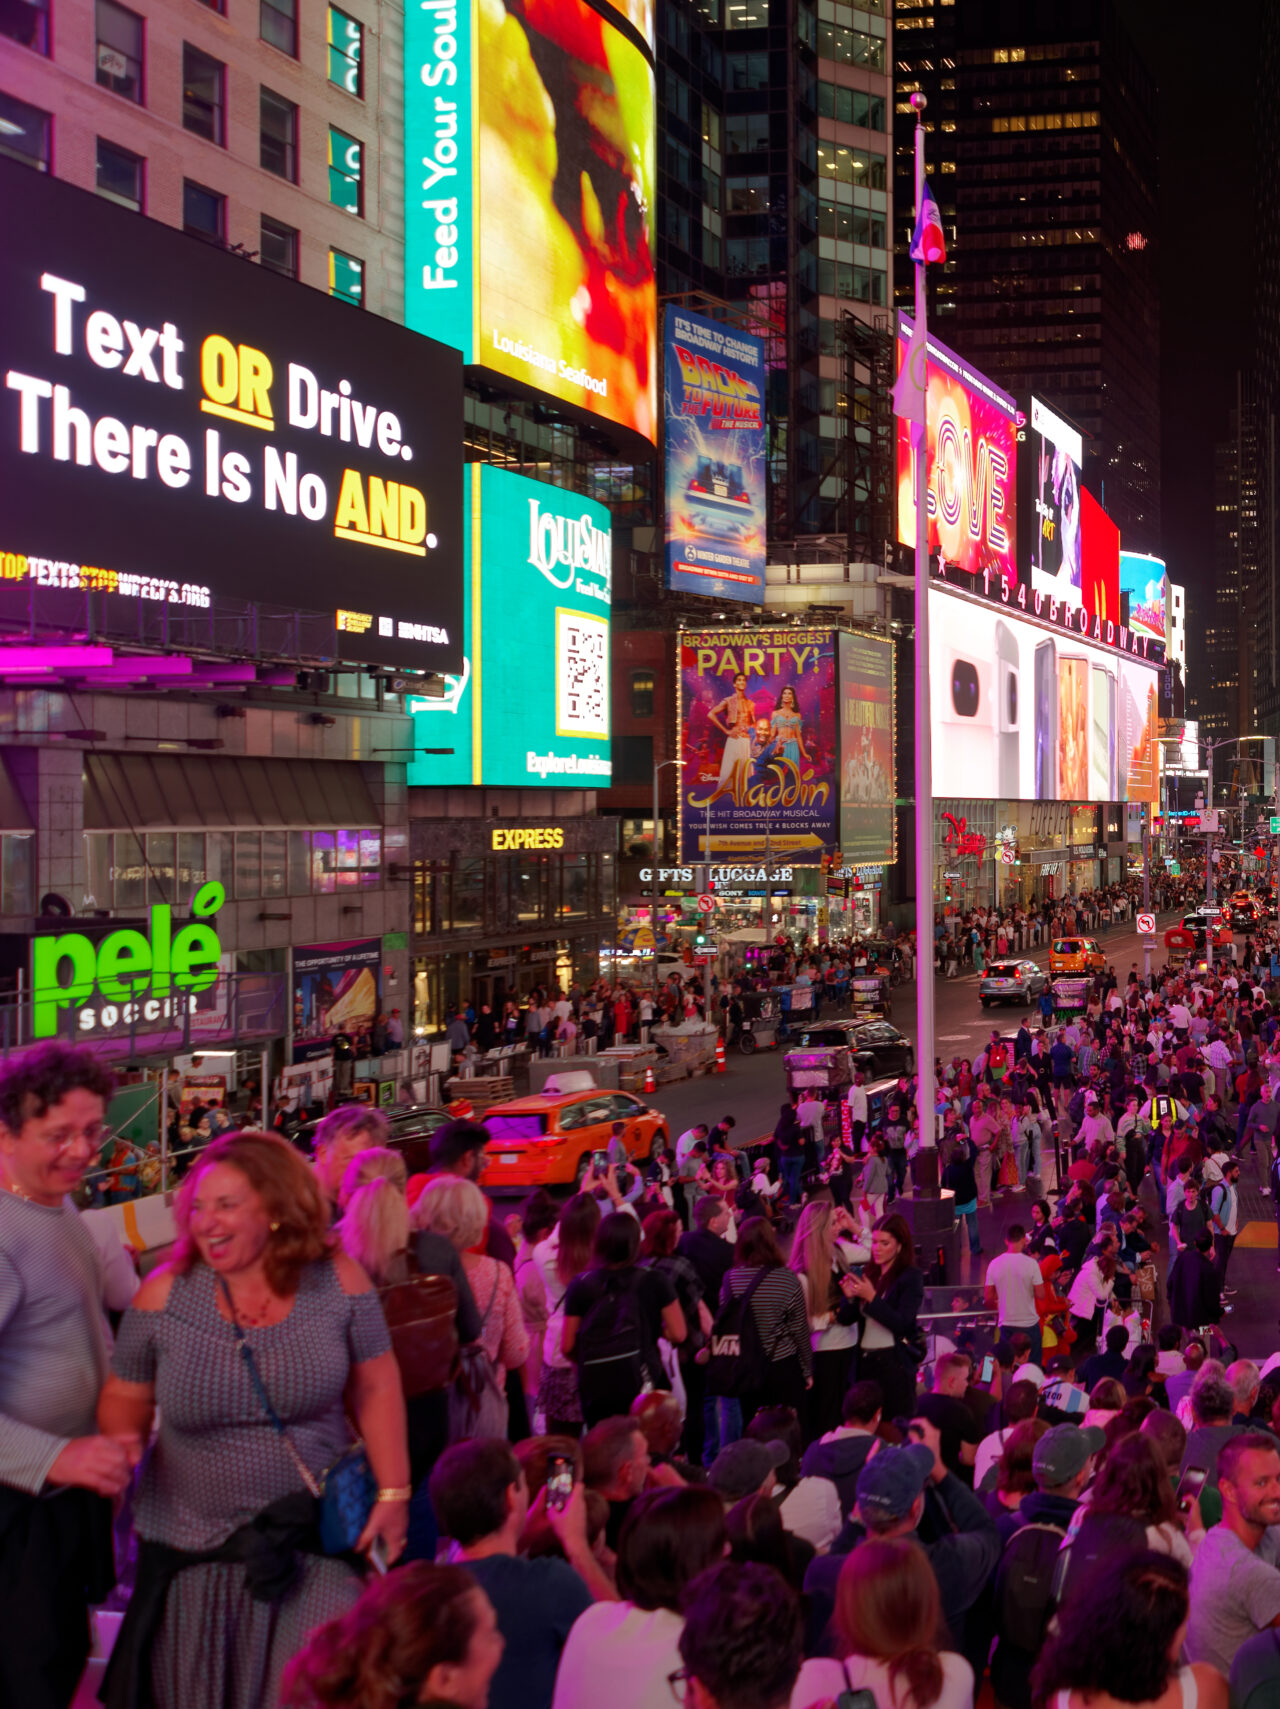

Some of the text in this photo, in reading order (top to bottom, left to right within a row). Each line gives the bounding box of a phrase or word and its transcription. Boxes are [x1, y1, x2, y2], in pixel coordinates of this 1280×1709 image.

[420, 0, 459, 290] Feed Your Soul
[675, 316, 758, 357] IT'S TIME TO CHANGE
[675, 328, 759, 368] BROADWAY HISTORY!
[41, 272, 414, 462] Text OR Drive.
[492, 328, 608, 398] Louisiana Seafood
[672, 342, 752, 400] BACK
[681, 388, 761, 421] THE FUTURE
[683, 384, 700, 402] TO
[721, 420, 760, 429] THE MUSICAL
[6, 370, 438, 549] There Is No AND.
[1043, 519, 1056, 541] ART
[983, 567, 1149, 658] 1540 BROADWAY
[410, 622, 450, 645] NHTSA
[682, 631, 832, 648] BROADWAY'S BIGGEST
[697, 646, 820, 677] PARTY!
[687, 757, 830, 808] Aladdin
[700, 808, 821, 818] THE HIT BROADWAY MUSICAL
[492, 827, 564, 851] EXPRESS
[640, 868, 793, 882] GFTS LUGGAGE
[34, 880, 226, 1038] pelé
[295, 960, 306, 968] THE
[306, 955, 344, 967] OPPORTUNITY
[356, 952, 379, 960] LIFETIME
[80, 994, 198, 1031] SOCCER
